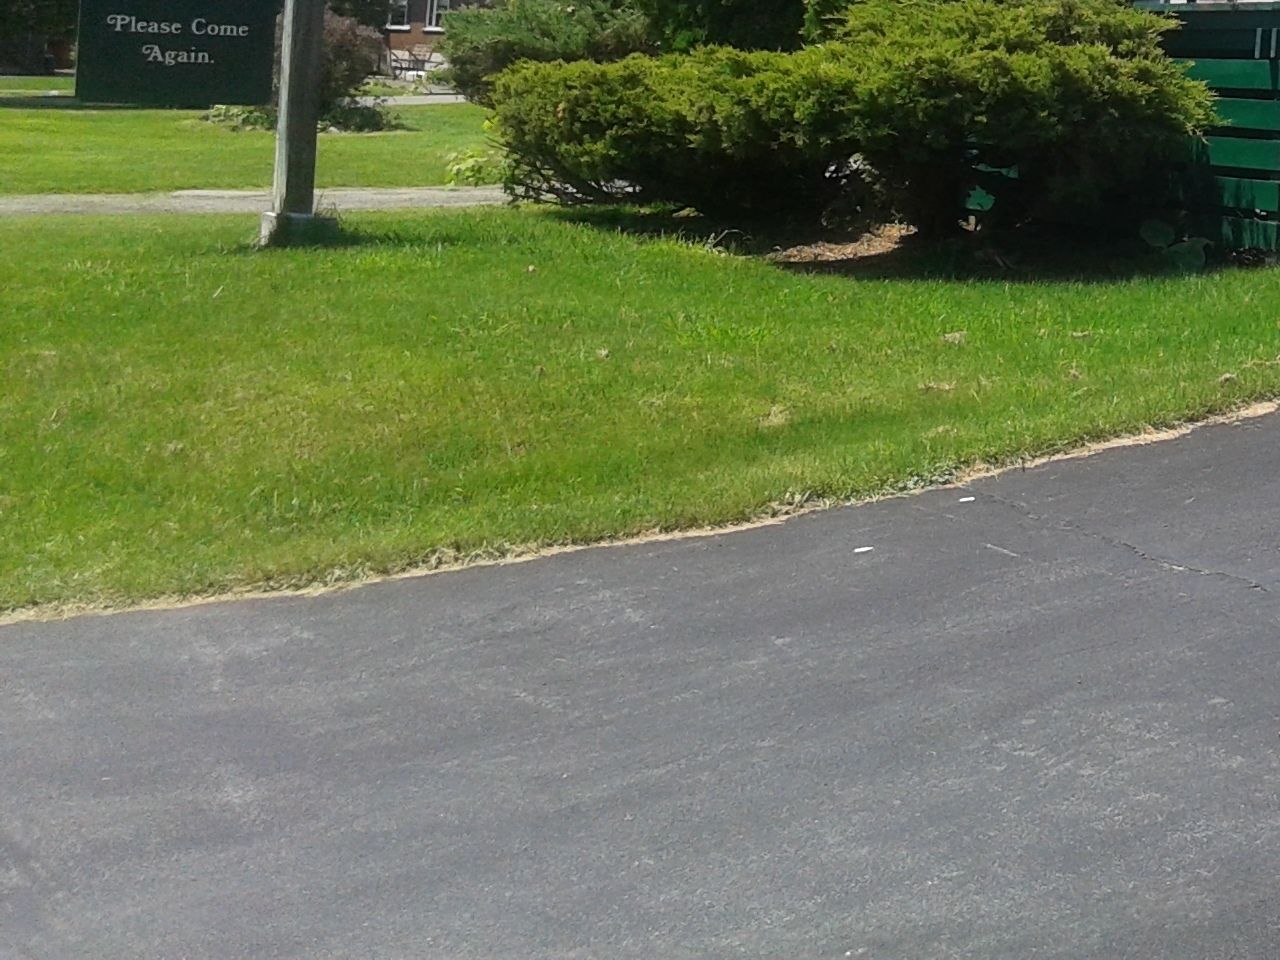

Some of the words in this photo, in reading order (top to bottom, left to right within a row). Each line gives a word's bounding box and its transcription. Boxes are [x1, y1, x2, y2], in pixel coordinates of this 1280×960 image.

[106, 14, 182, 34] Please
[191, 18, 249, 37] Come
[142, 44, 215, 66] Again.
